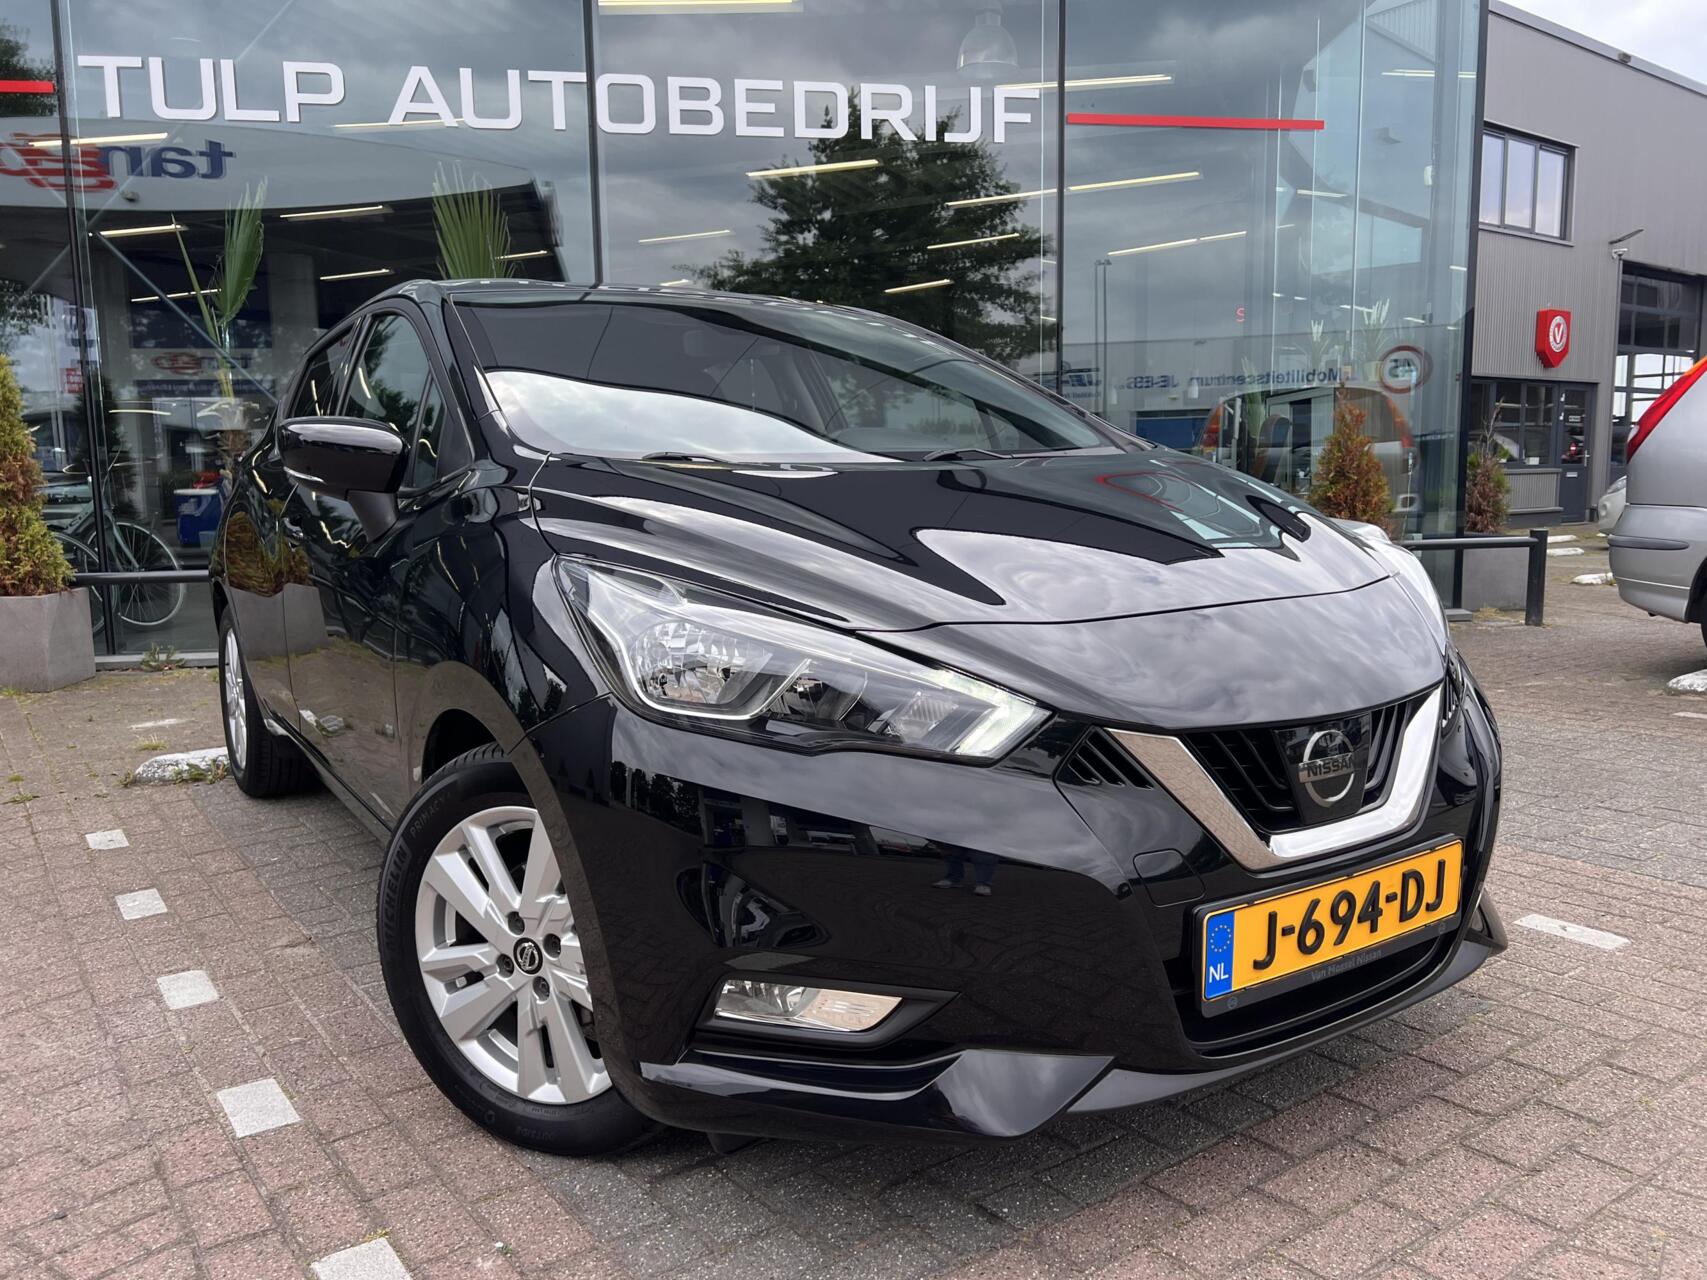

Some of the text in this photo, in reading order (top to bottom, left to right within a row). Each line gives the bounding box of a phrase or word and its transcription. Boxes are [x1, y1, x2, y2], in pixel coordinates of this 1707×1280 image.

[78, 55, 1040, 143] TULP AUTOBEDRIJF
[384, 846, 408, 951] MICHELIN
[1252, 859, 1446, 970] J-694-DJ
[1208, 962, 1230, 984] NL
